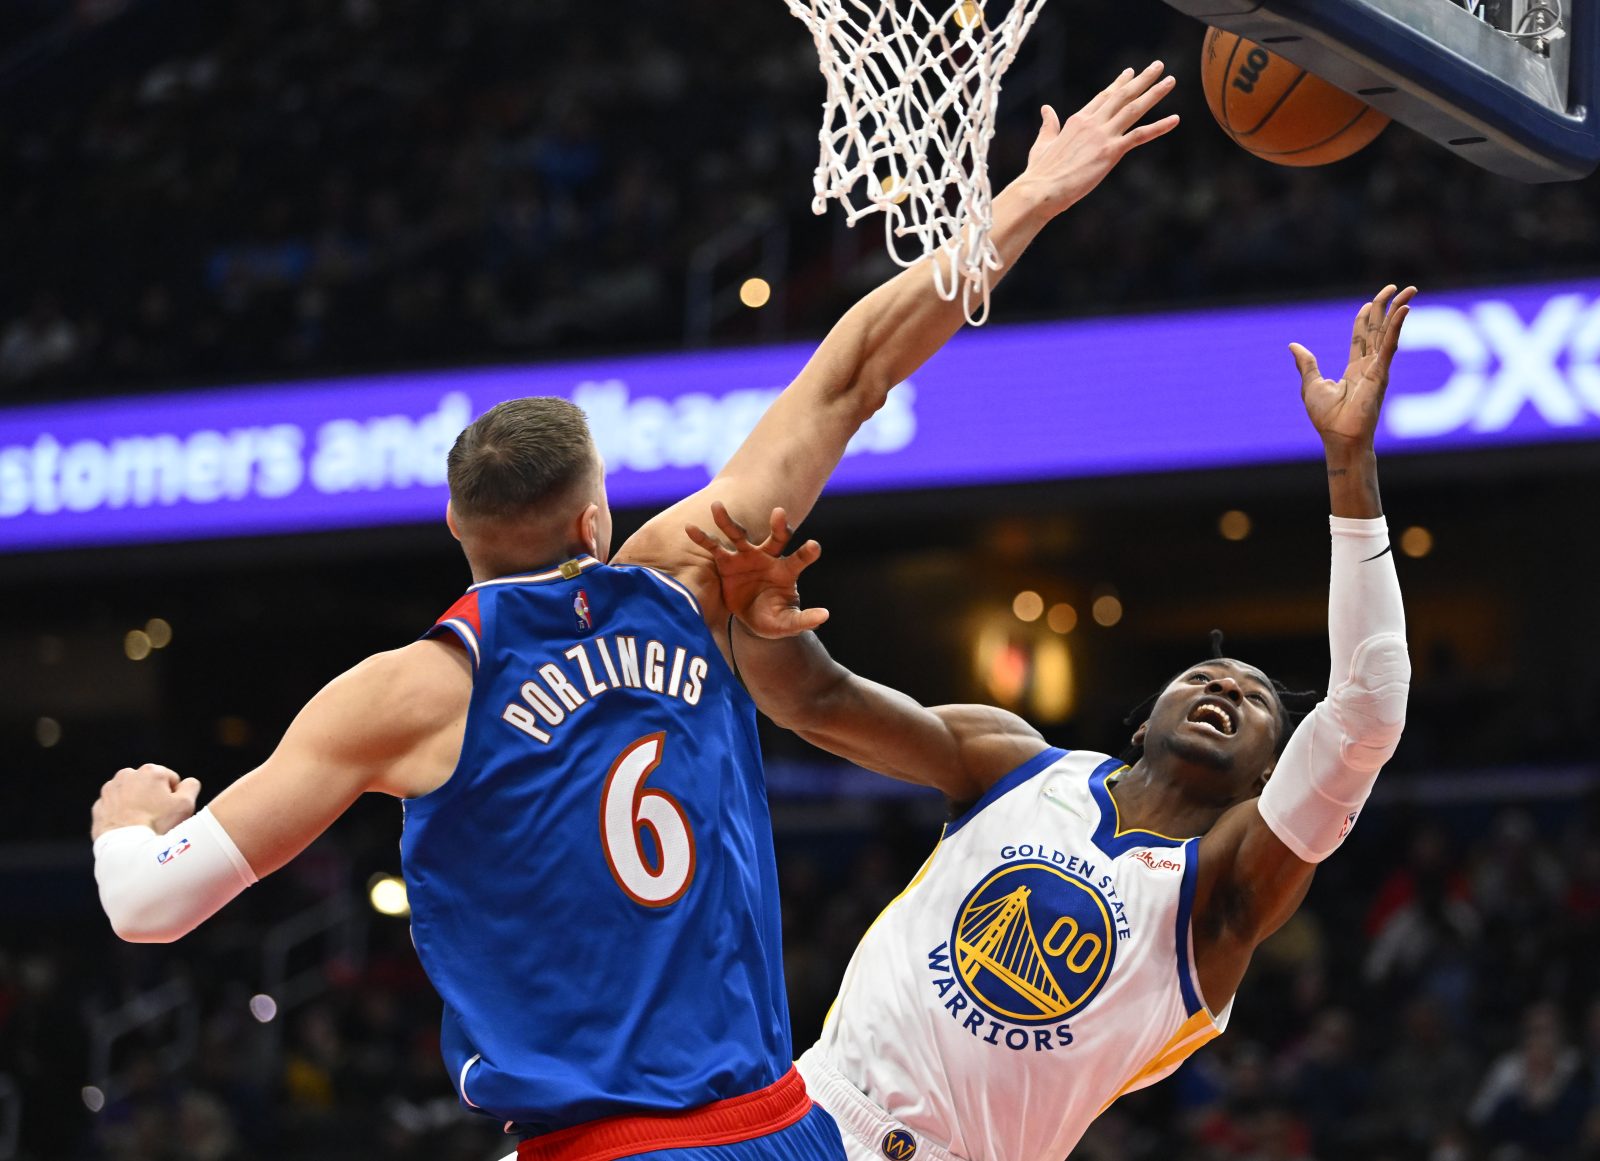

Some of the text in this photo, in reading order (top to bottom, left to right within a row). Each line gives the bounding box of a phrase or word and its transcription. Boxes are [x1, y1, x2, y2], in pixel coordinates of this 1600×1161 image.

[309, 391, 471, 492] and
[502, 636, 709, 744] PORZINGIS
[599, 730, 697, 908] 6
[1000, 844, 1132, 941] GOLDEN STATE
[928, 941, 1074, 1051] WARRIORS
[1042, 916, 1102, 974] 00
